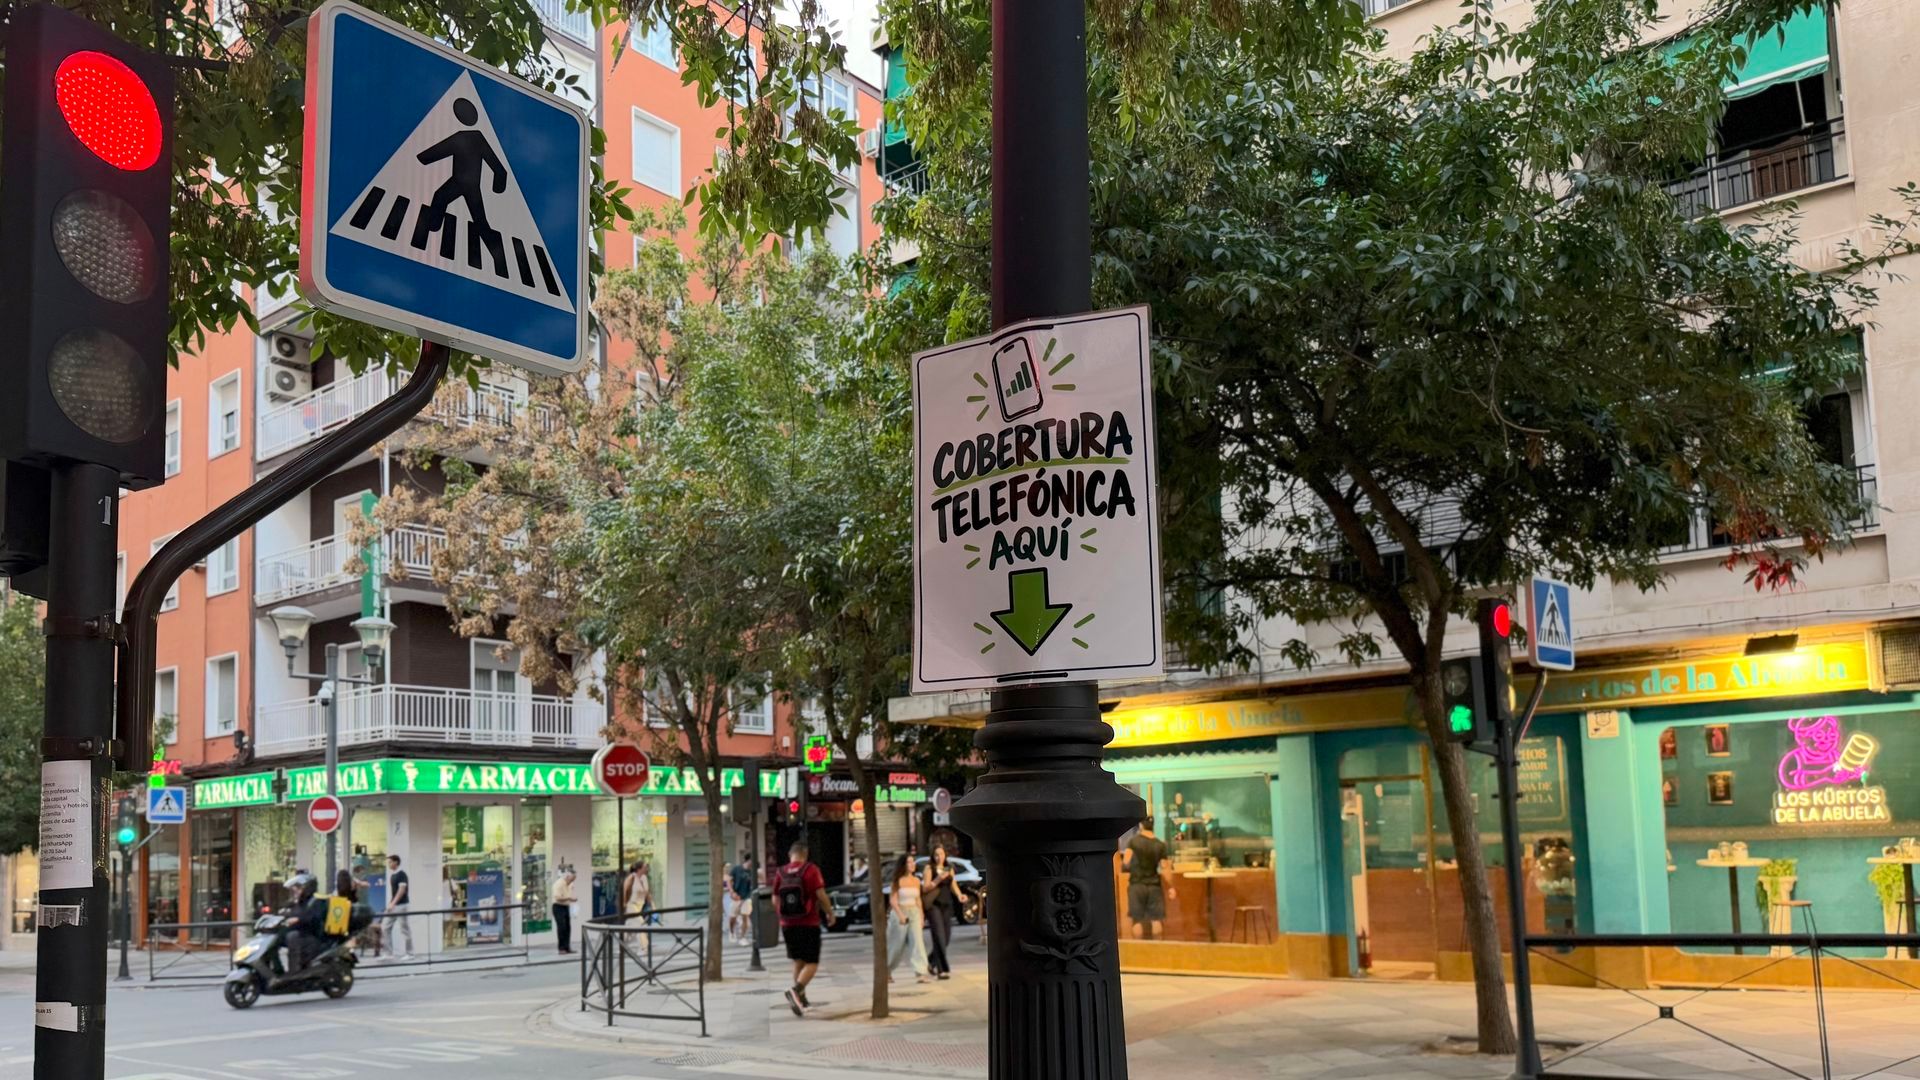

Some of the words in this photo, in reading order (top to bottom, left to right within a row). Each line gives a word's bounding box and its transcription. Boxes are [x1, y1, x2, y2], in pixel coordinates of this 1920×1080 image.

[933, 410, 1133, 489] COBERTURA
[931, 467, 1136, 543] TELEFÓNICA
[989, 517, 1073, 571] AQUÍ
[1641, 668, 1680, 695] de
[1687, 664, 1716, 692] la
[438, 765, 597, 791] FARMACIA
[606, 763, 645, 776] STOP
[194, 778, 269, 806] FARMACIA
[1778, 791, 1810, 807] LOS
[1812, 786, 1881, 806] KÜRTOS
[1775, 808, 1797, 823] DE
[1799, 807, 1820, 822] LA
[1822, 804, 1885, 820] ABUELA
